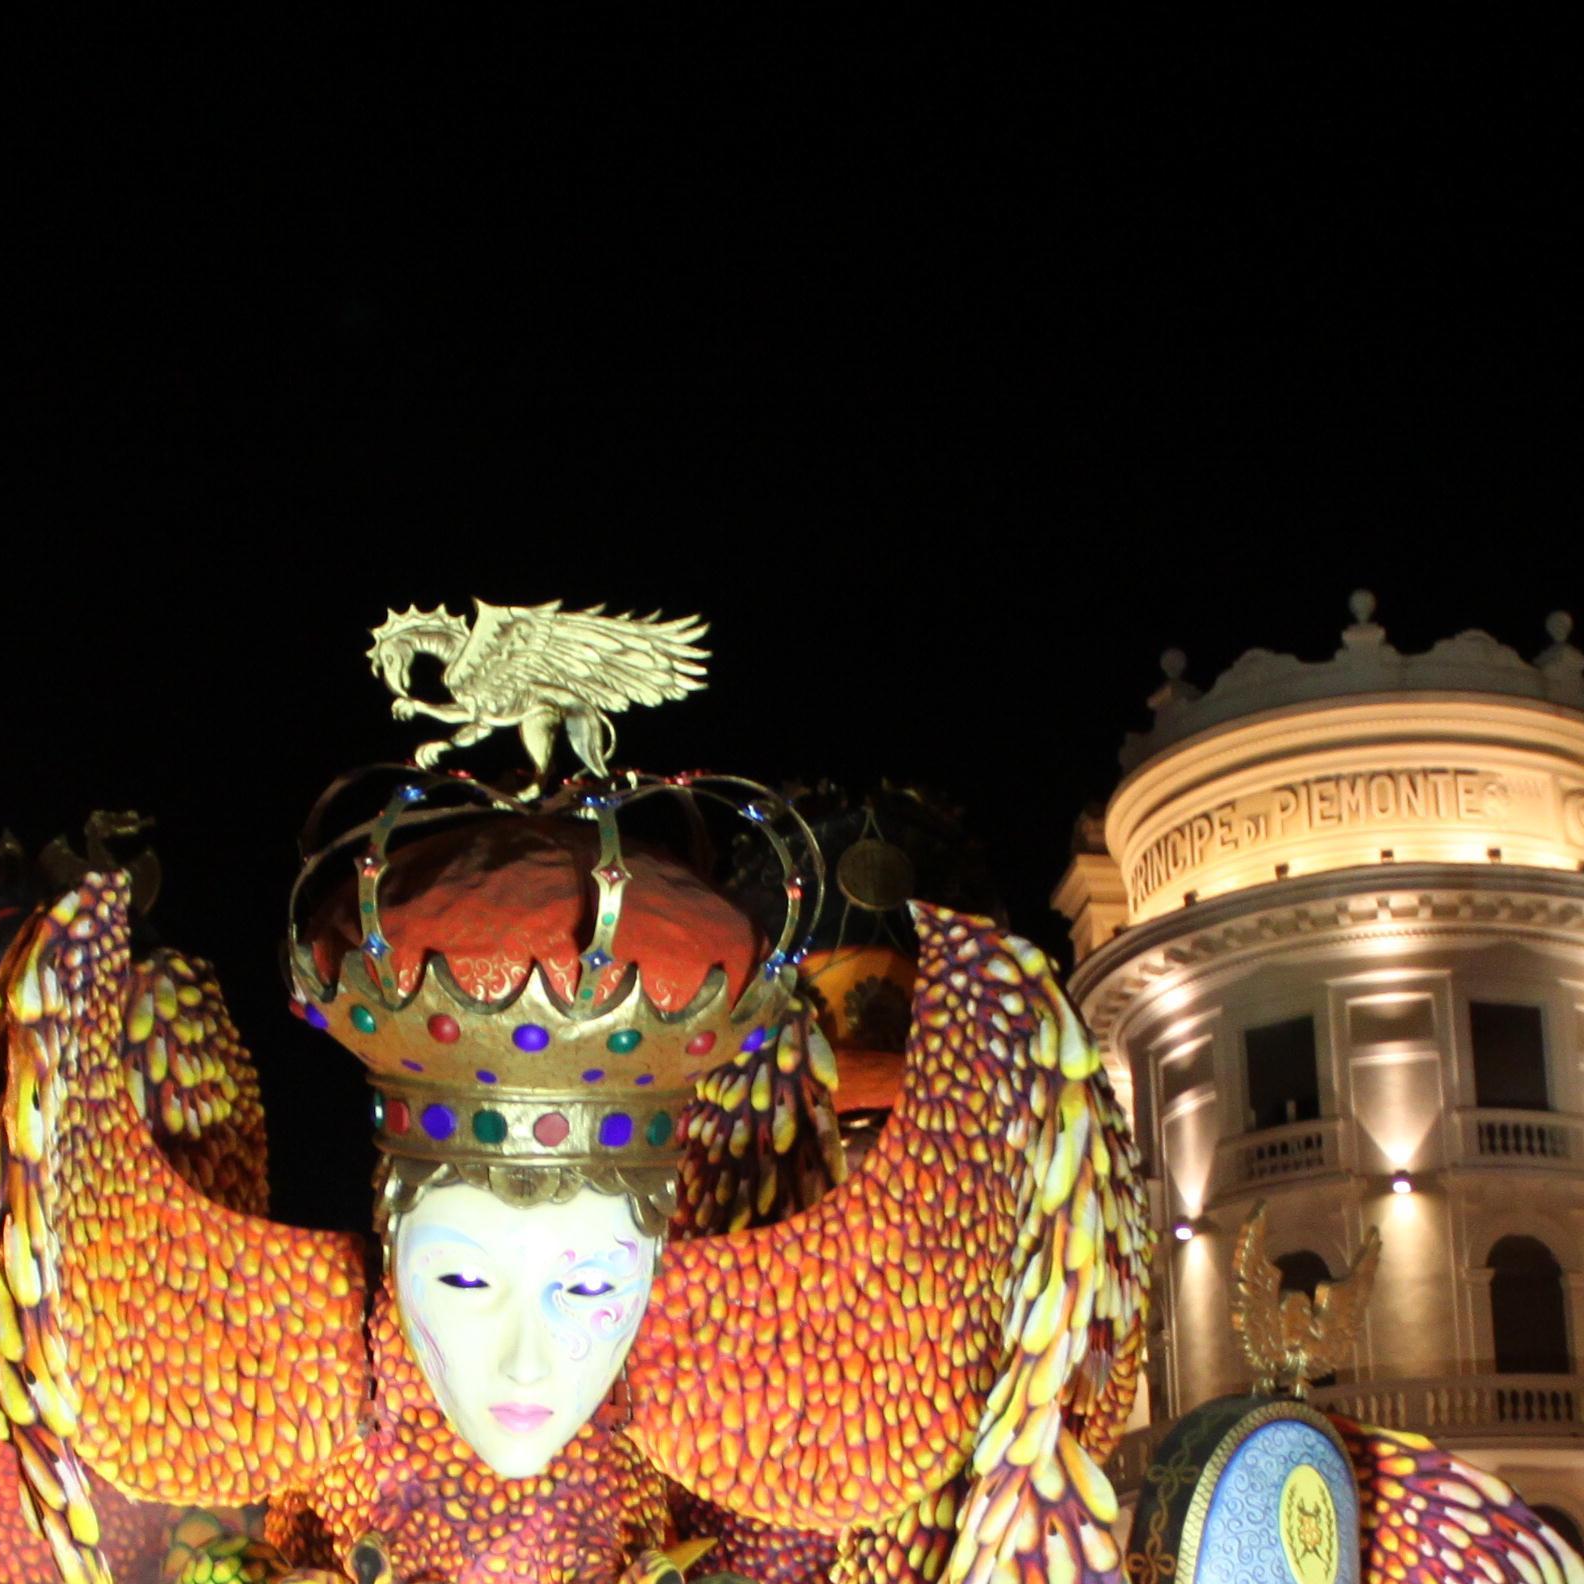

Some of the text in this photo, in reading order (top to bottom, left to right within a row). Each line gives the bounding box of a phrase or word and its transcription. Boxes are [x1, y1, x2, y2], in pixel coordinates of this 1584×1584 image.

[1128, 767, 1483, 914] PRINCIPE DI PIEMONTE
